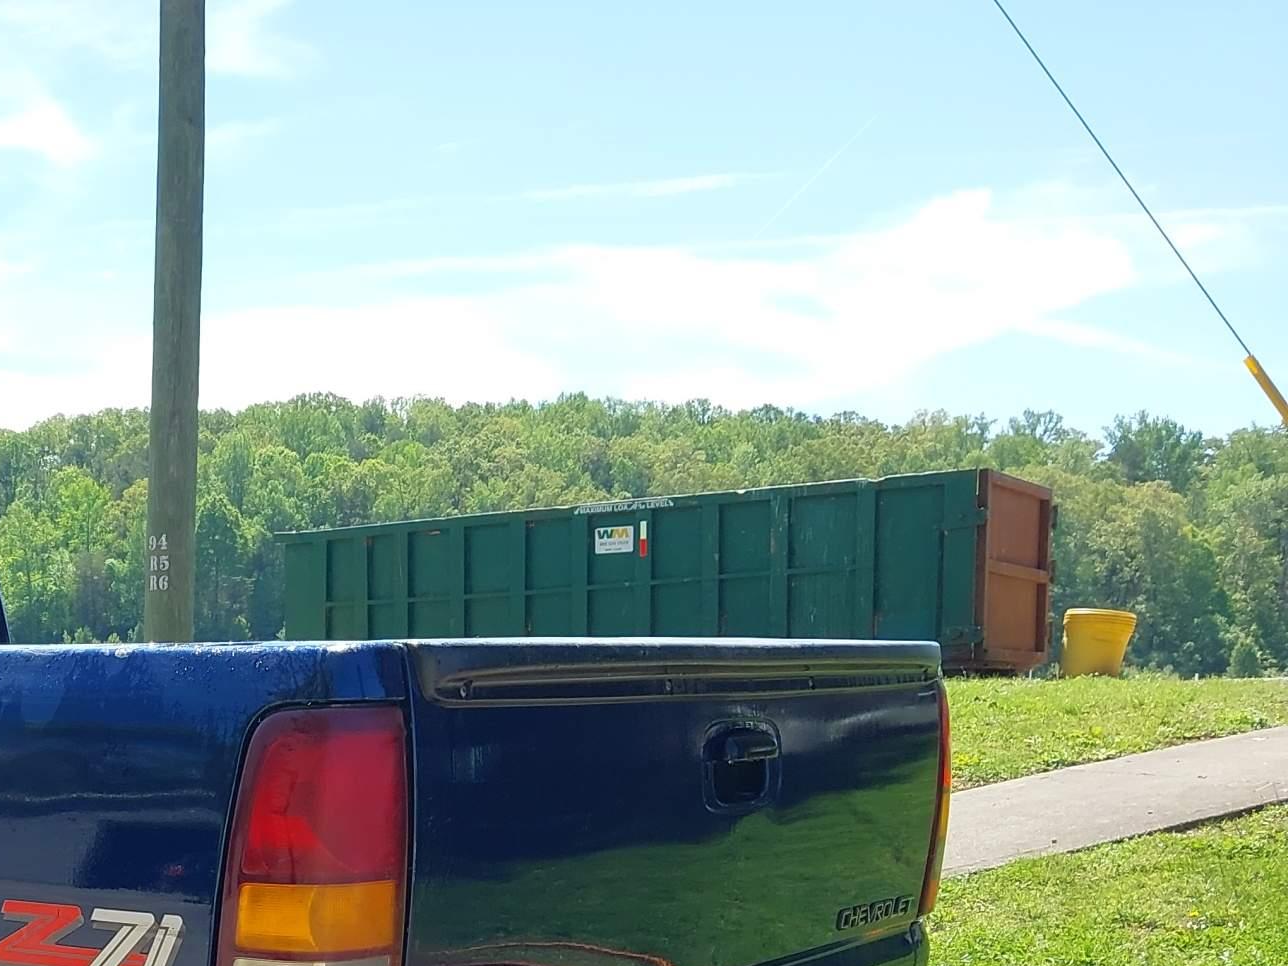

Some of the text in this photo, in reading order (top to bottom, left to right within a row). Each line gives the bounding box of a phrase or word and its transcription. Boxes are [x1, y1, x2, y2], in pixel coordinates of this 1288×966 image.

[597, 528, 630, 539] WM
[150, 555, 170, 571] R5
[149, 575, 169, 591] R6
[836, 895, 914, 931] CHEVROLET
